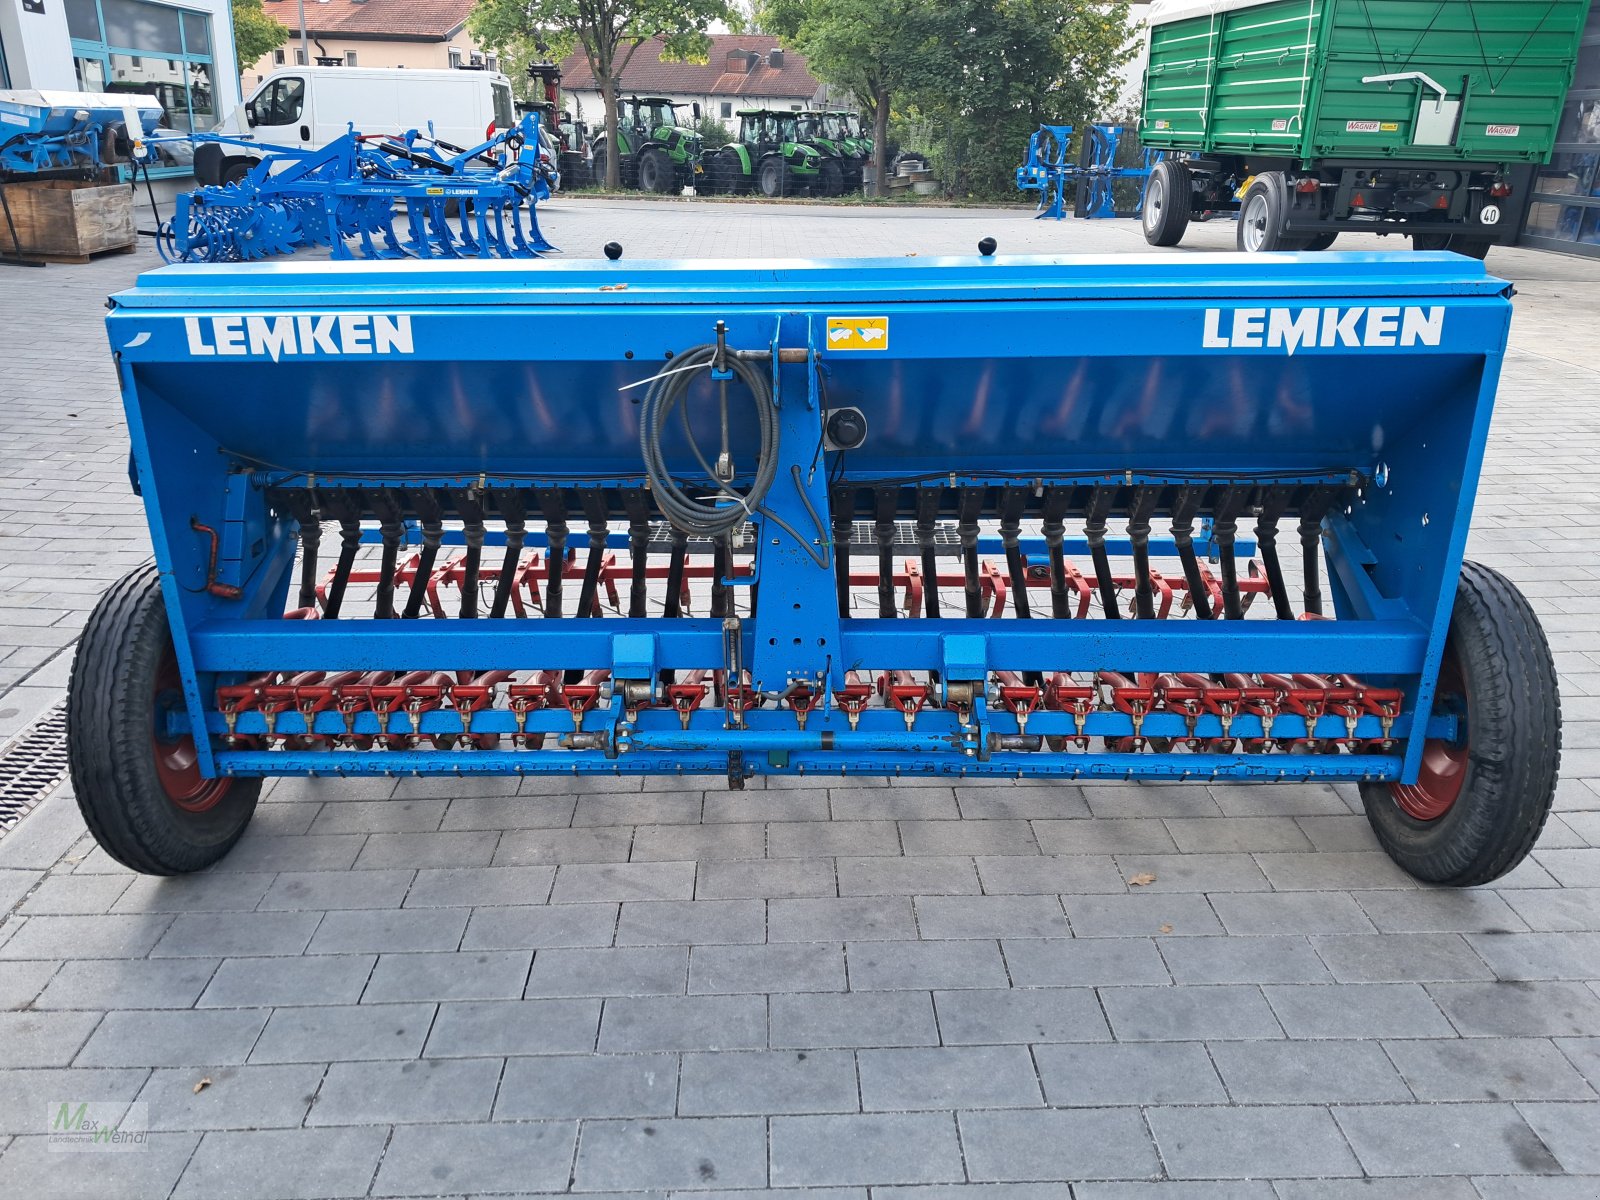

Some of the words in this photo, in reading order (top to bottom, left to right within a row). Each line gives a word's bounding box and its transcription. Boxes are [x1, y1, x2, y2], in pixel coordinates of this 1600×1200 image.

[1347, 121, 1378, 130] WAGNER
[1487, 125, 1517, 135] WAGNER
[1483, 209, 1497, 222] 40
[1202, 306, 1446, 357] LEMKEN
[184, 315, 414, 363] LEMKEN
